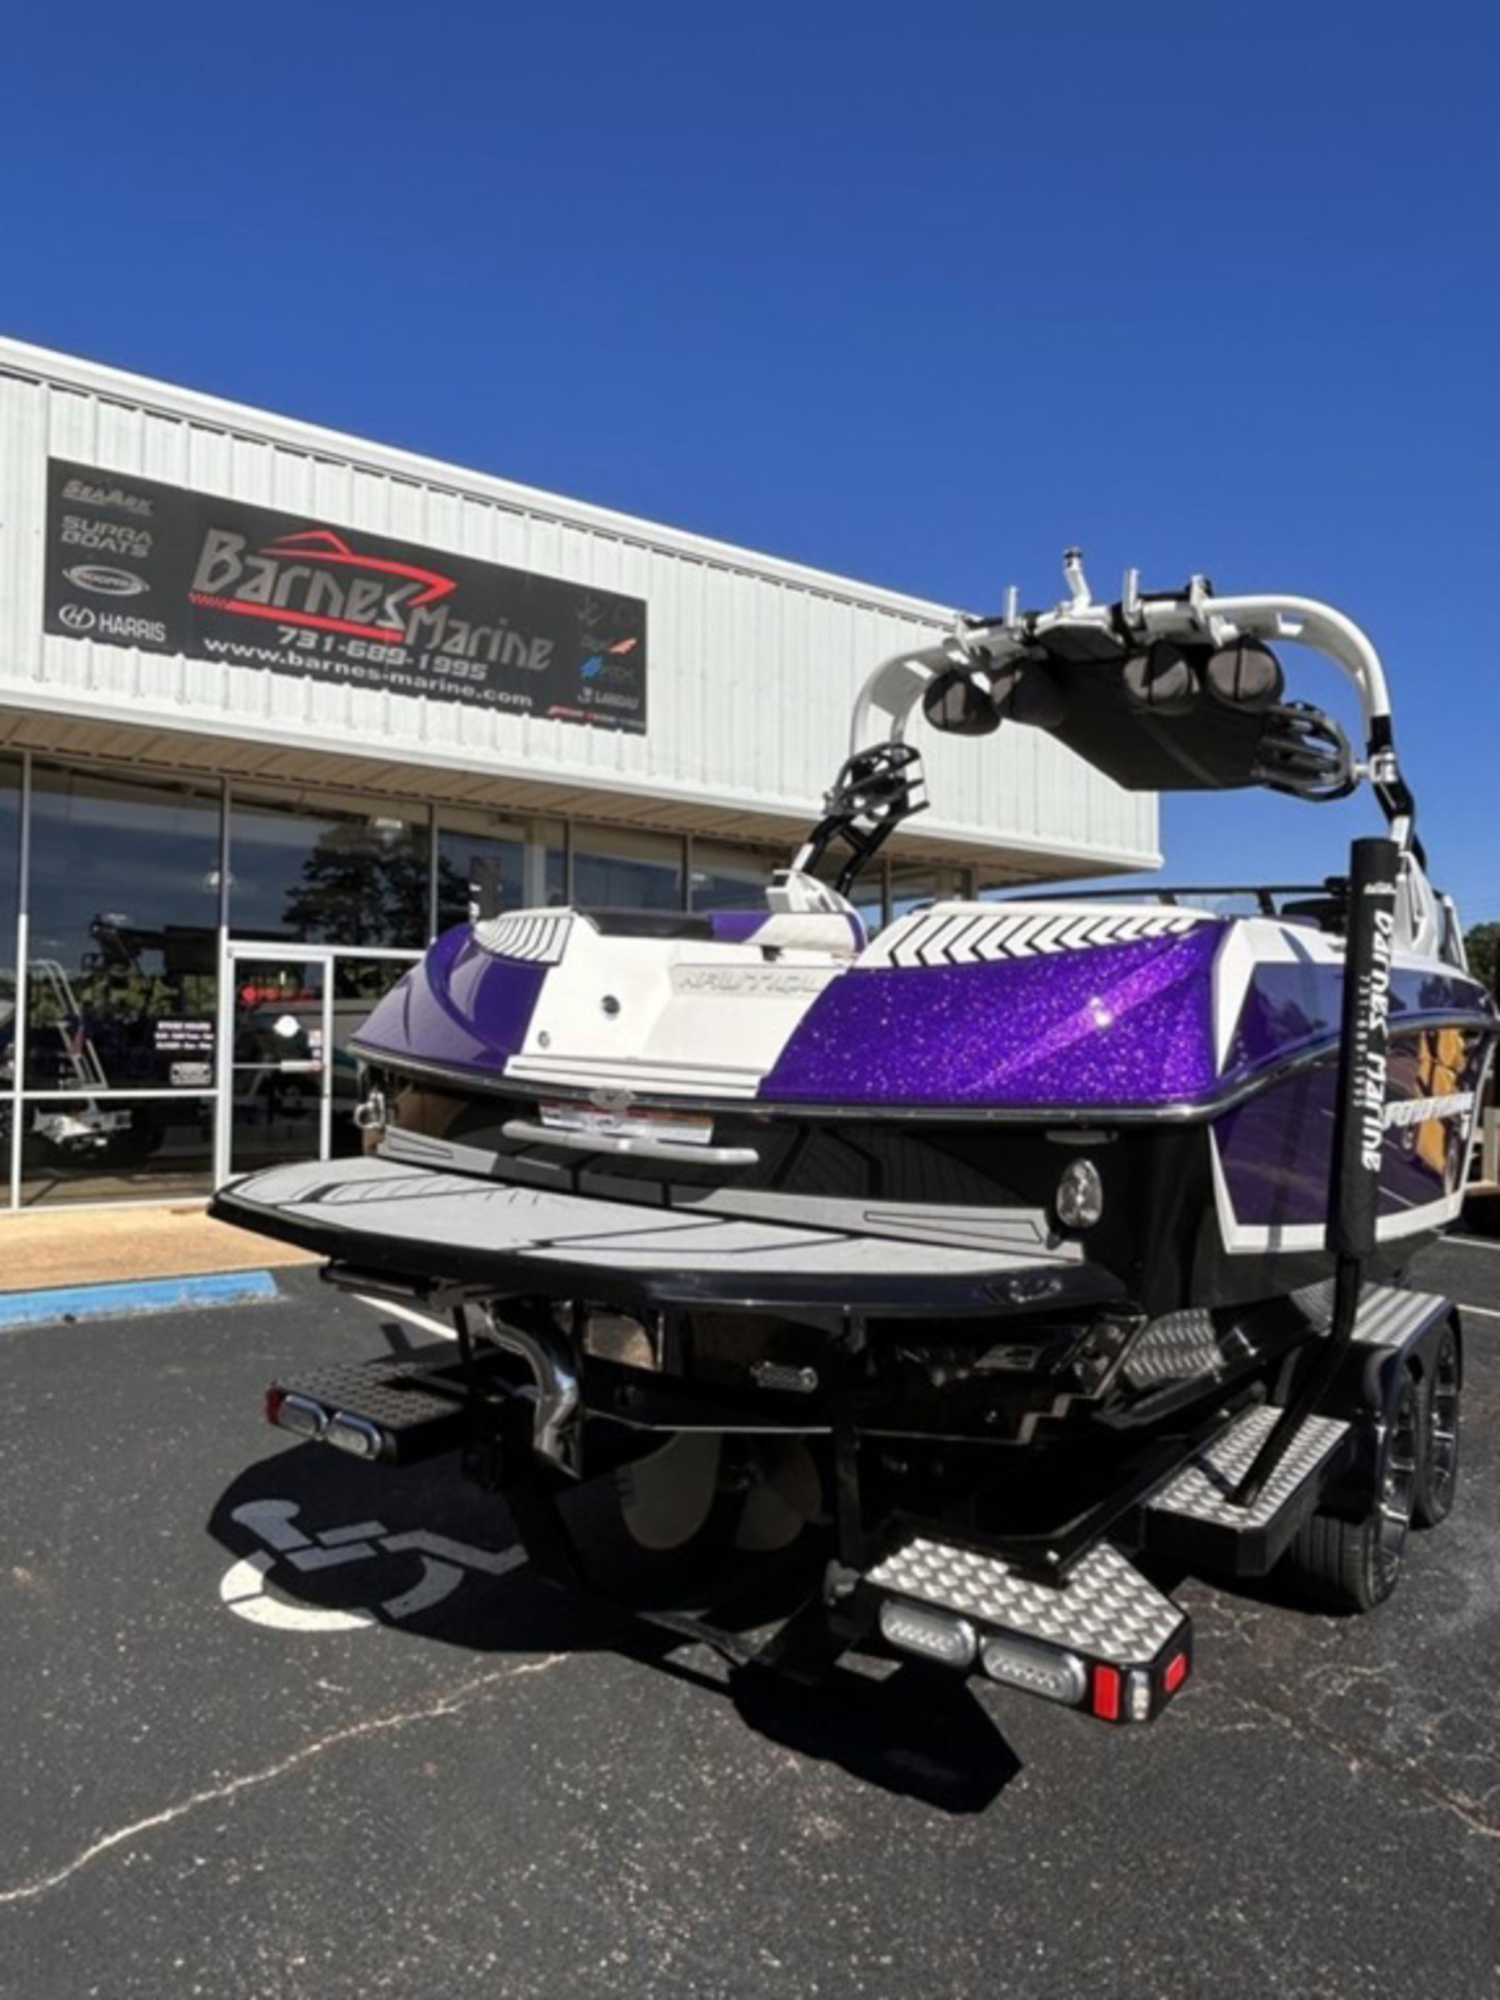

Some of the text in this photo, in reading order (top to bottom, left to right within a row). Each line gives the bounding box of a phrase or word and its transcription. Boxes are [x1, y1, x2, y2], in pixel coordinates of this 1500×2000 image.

[99, 611, 167, 643] HARRIS
[277, 625, 489, 682] 731-689-1995
[203, 637, 533, 707] www.barnes-marine.com
